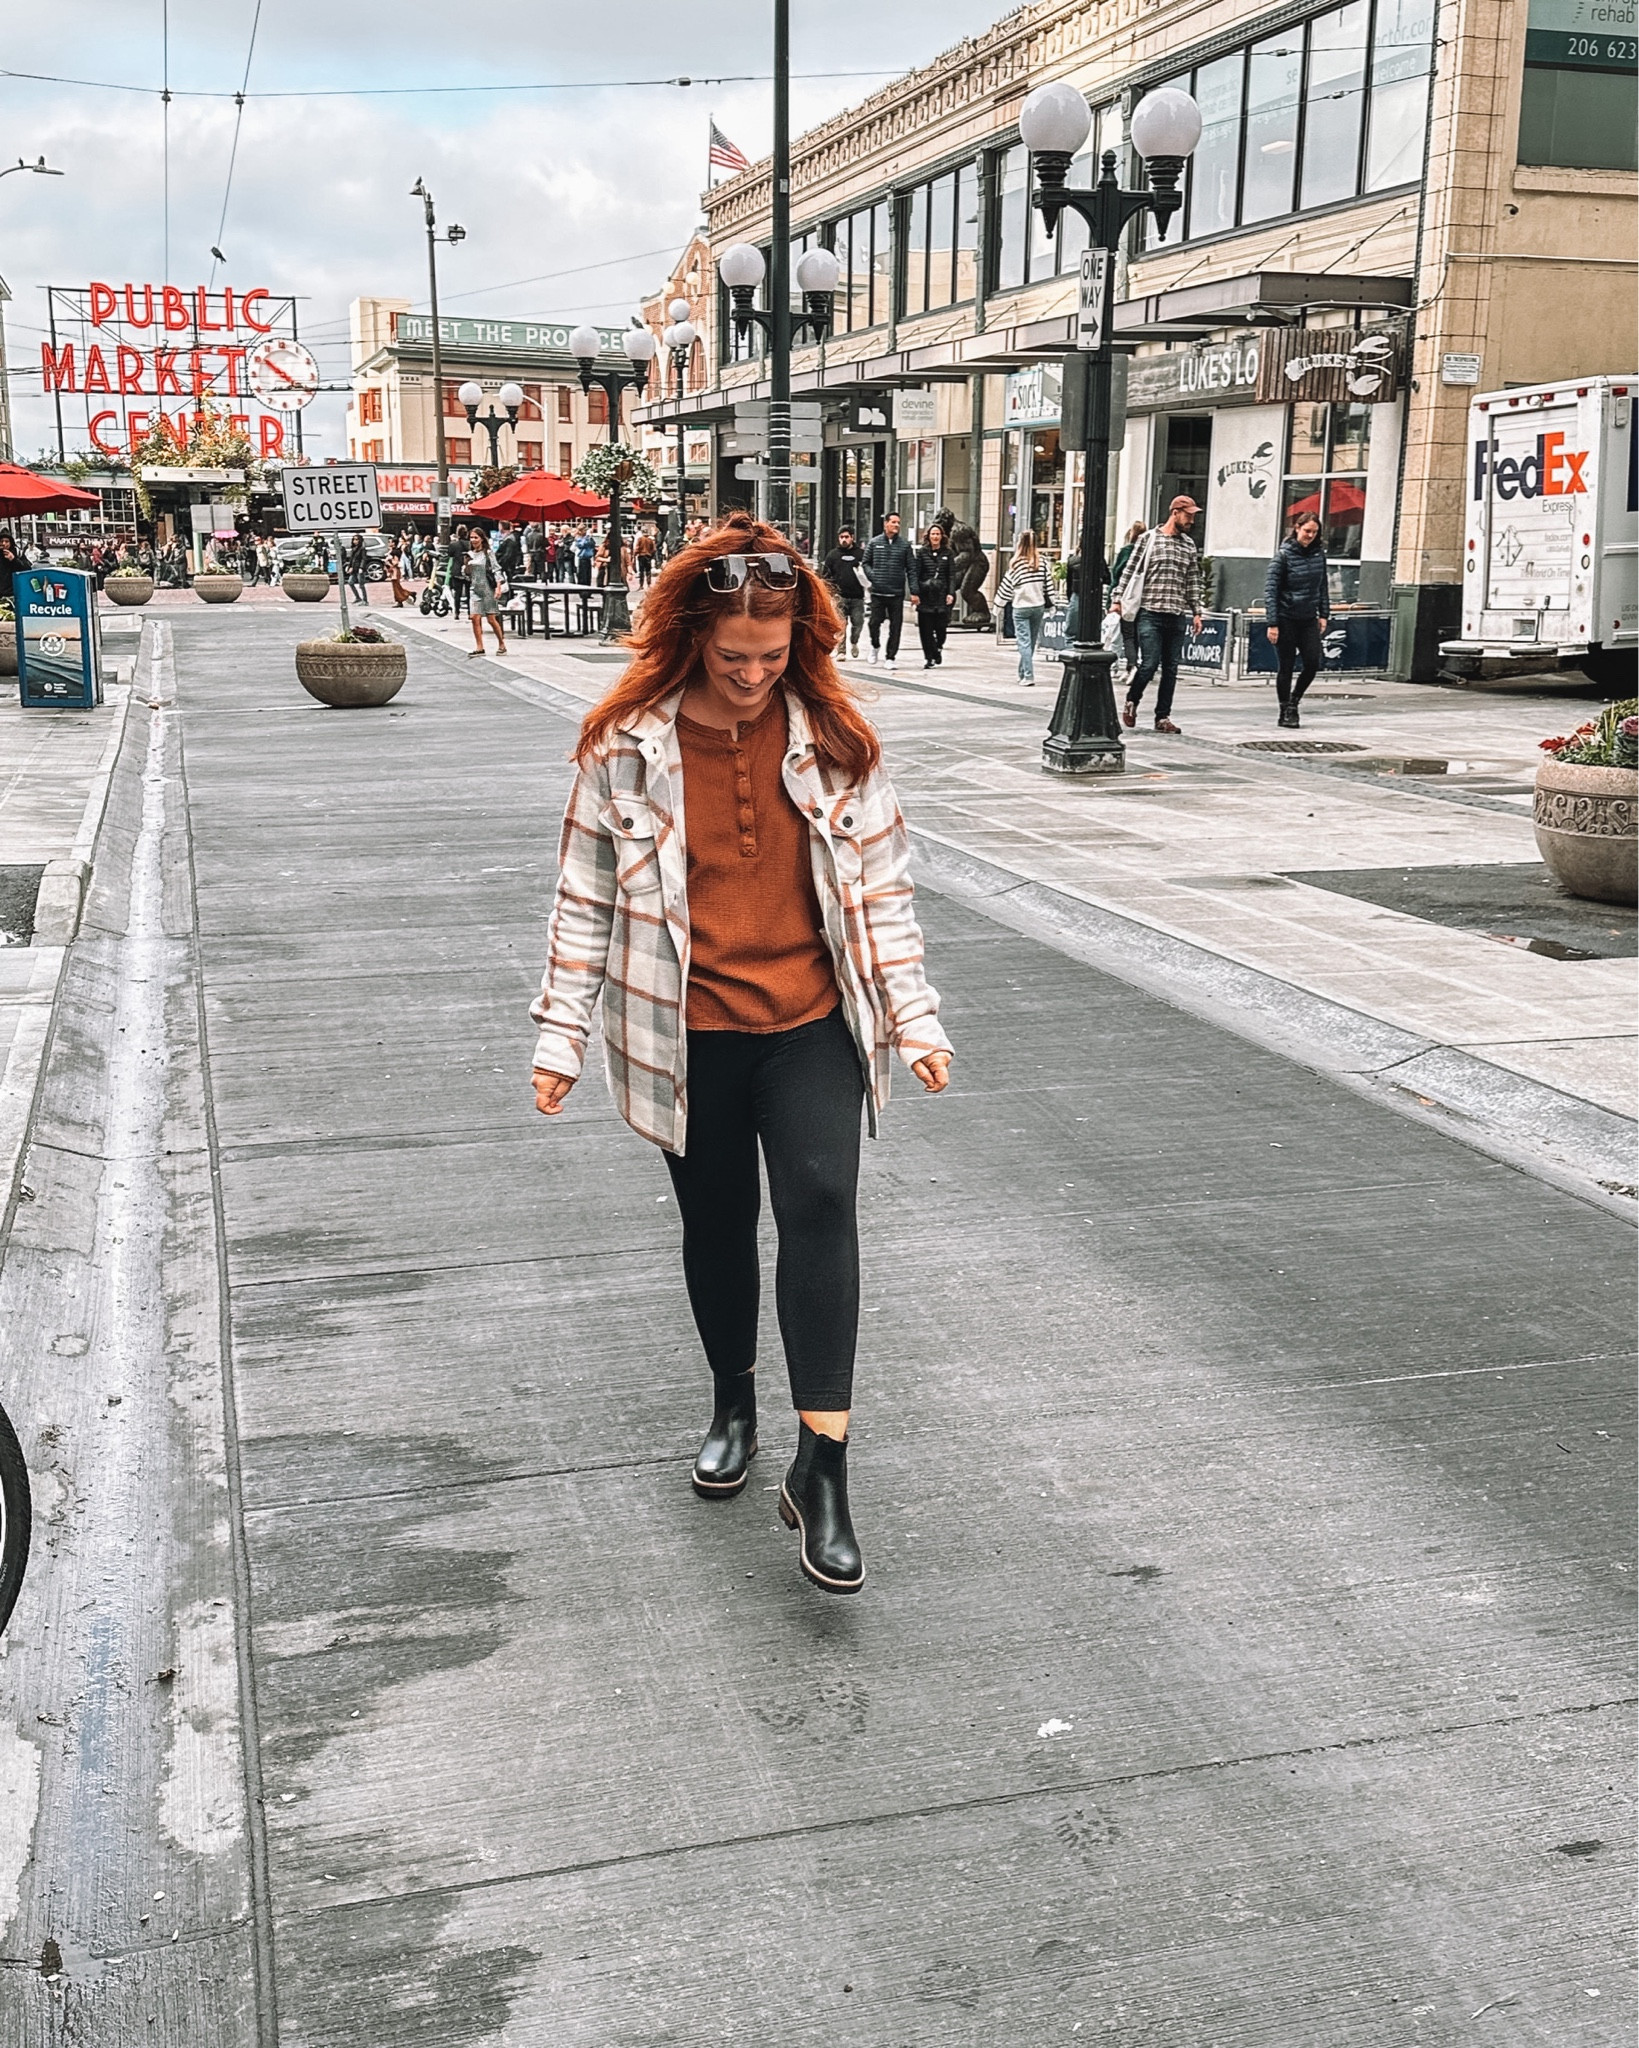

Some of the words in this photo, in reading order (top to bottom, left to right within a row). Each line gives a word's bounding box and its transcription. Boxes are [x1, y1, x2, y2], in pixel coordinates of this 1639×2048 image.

[1591, 4, 1635, 24] rehab
[1568, 37, 1598, 57] 206
[1607, 40, 1637, 60] 623
[1083, 258, 1104, 280] ONE
[90, 281, 272, 333] PUBLIC
[1081, 286, 1102, 308] WAY
[406, 318, 462, 339] MEET
[473, 323, 513, 343] THE
[525, 326, 622, 350] PROCE
[41, 341, 247, 398] MARKET
[1179, 351, 1232, 393] LUKE'S
[901, 398, 934, 409] devine
[1474, 431, 1590, 501] FedEx
[292, 474, 368, 496] STREET
[376, 475, 436, 493] RMERS
[293, 500, 373, 522] CLOSED
[396, 503, 431, 512] MARKET
[1542, 499, 1574, 515] Express
[49, 537, 80, 545] MARKET
[29, 603, 73, 616] Recycle
